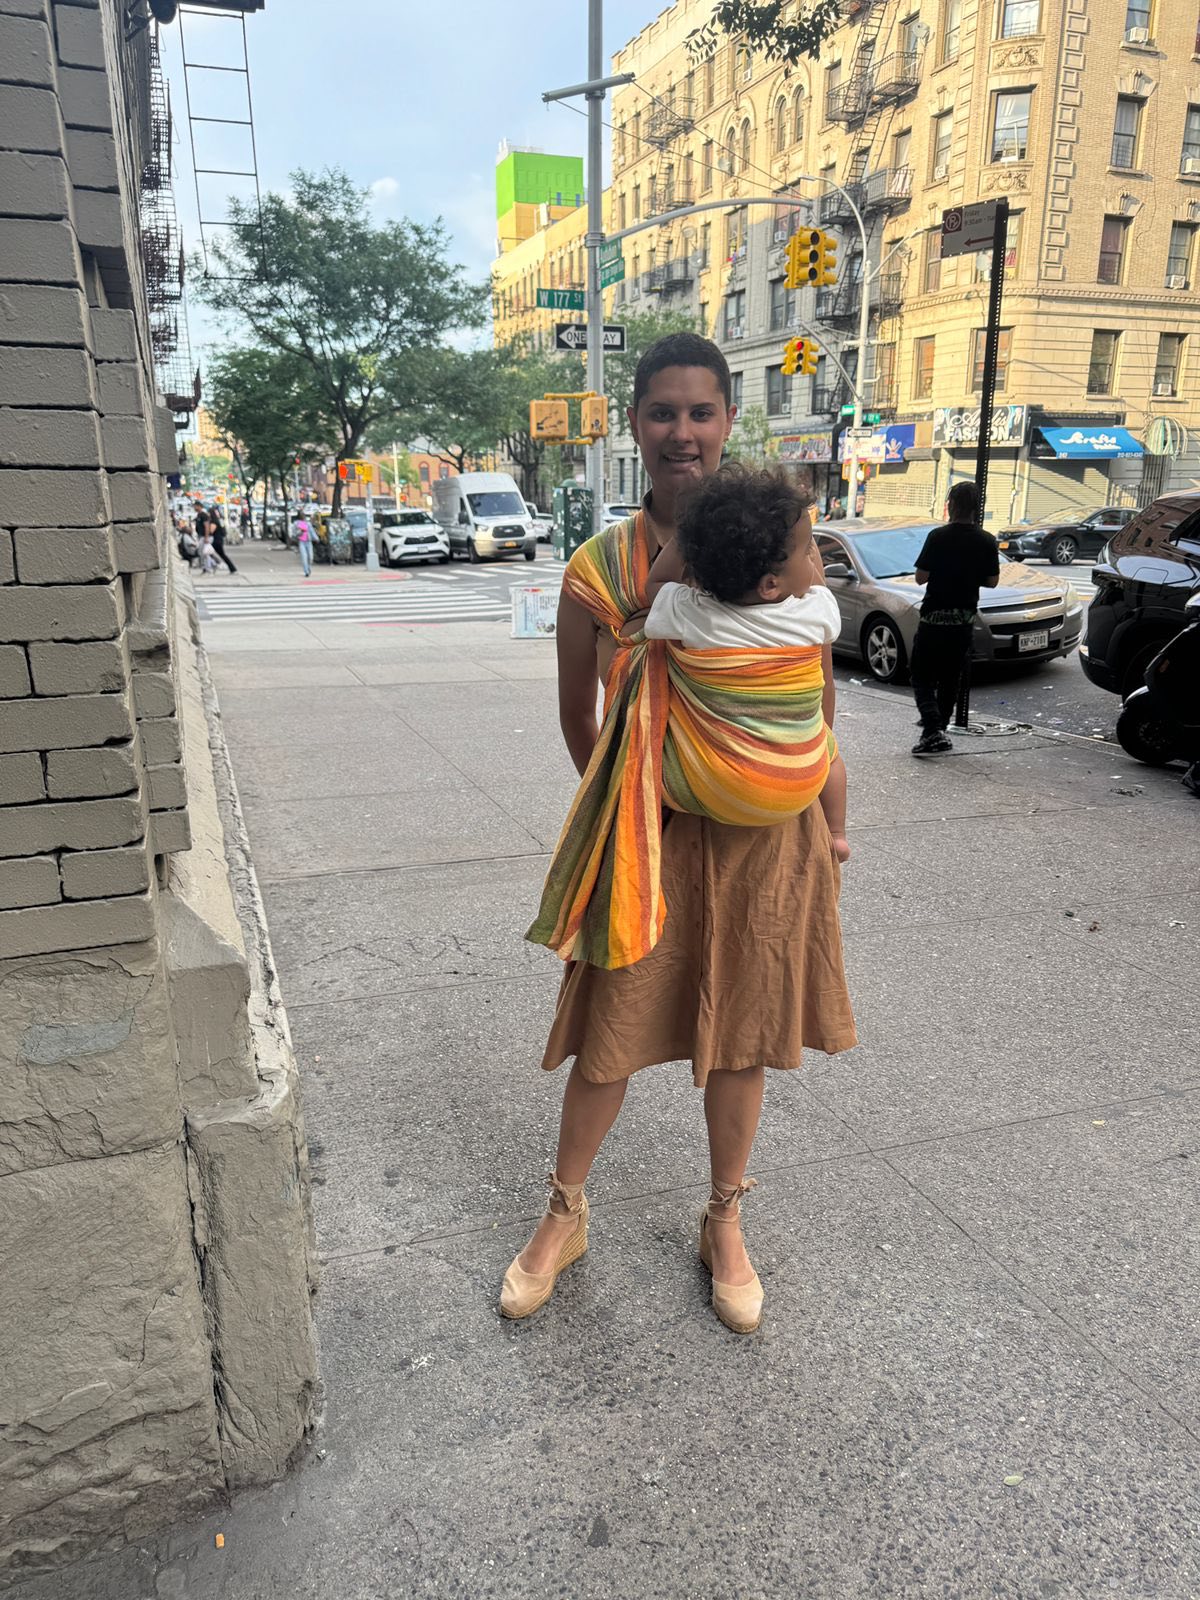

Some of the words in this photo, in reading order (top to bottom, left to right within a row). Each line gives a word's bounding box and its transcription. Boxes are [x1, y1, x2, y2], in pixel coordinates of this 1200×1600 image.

[540, 291, 549, 305] W
[554, 292, 570, 307] 177
[566, 331, 586, 342] ONE
[945, 426, 1010, 441] FASHON
